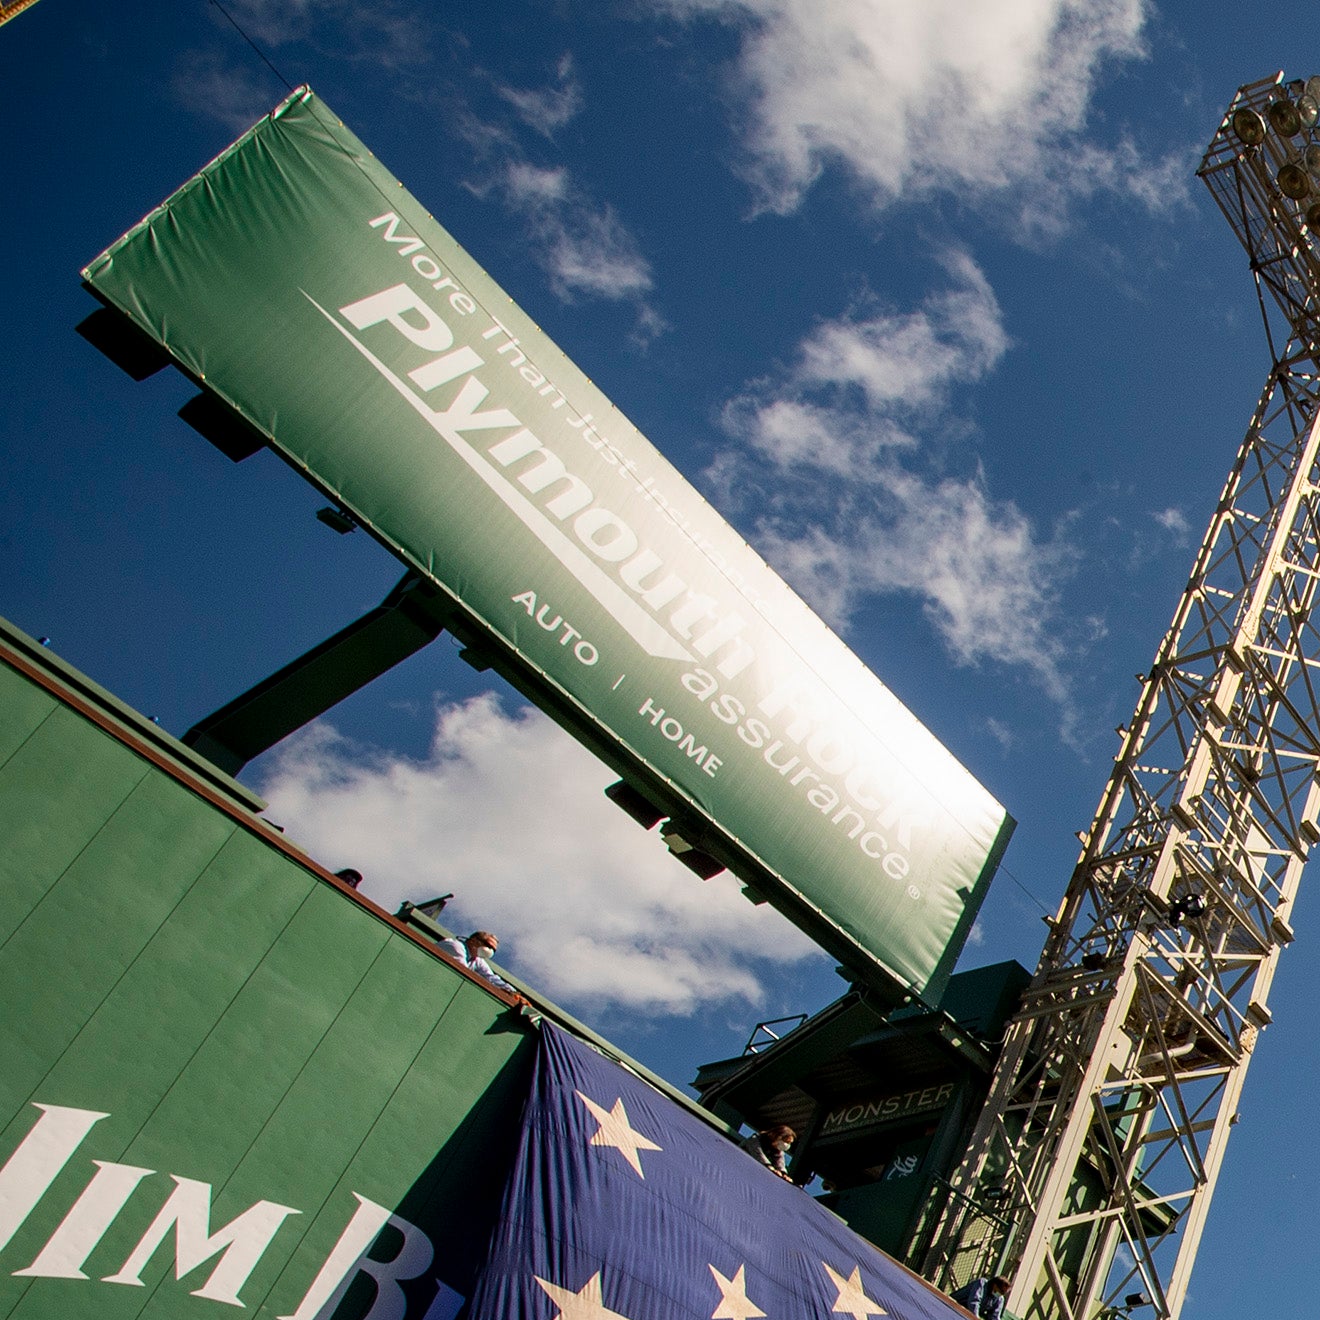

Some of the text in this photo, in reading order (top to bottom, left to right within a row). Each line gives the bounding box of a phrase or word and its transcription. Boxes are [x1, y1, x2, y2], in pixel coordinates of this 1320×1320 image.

[369, 212, 477, 316] More
[482, 316, 568, 409] Than
[567, 413, 638, 480] Just
[339, 283, 758, 680] Plymouth
[512, 590, 600, 666] AUTO
[637, 698, 724, 778] HOME
[681, 662, 910, 881] assurance
[822, 1083, 955, 1128] MONSTER
